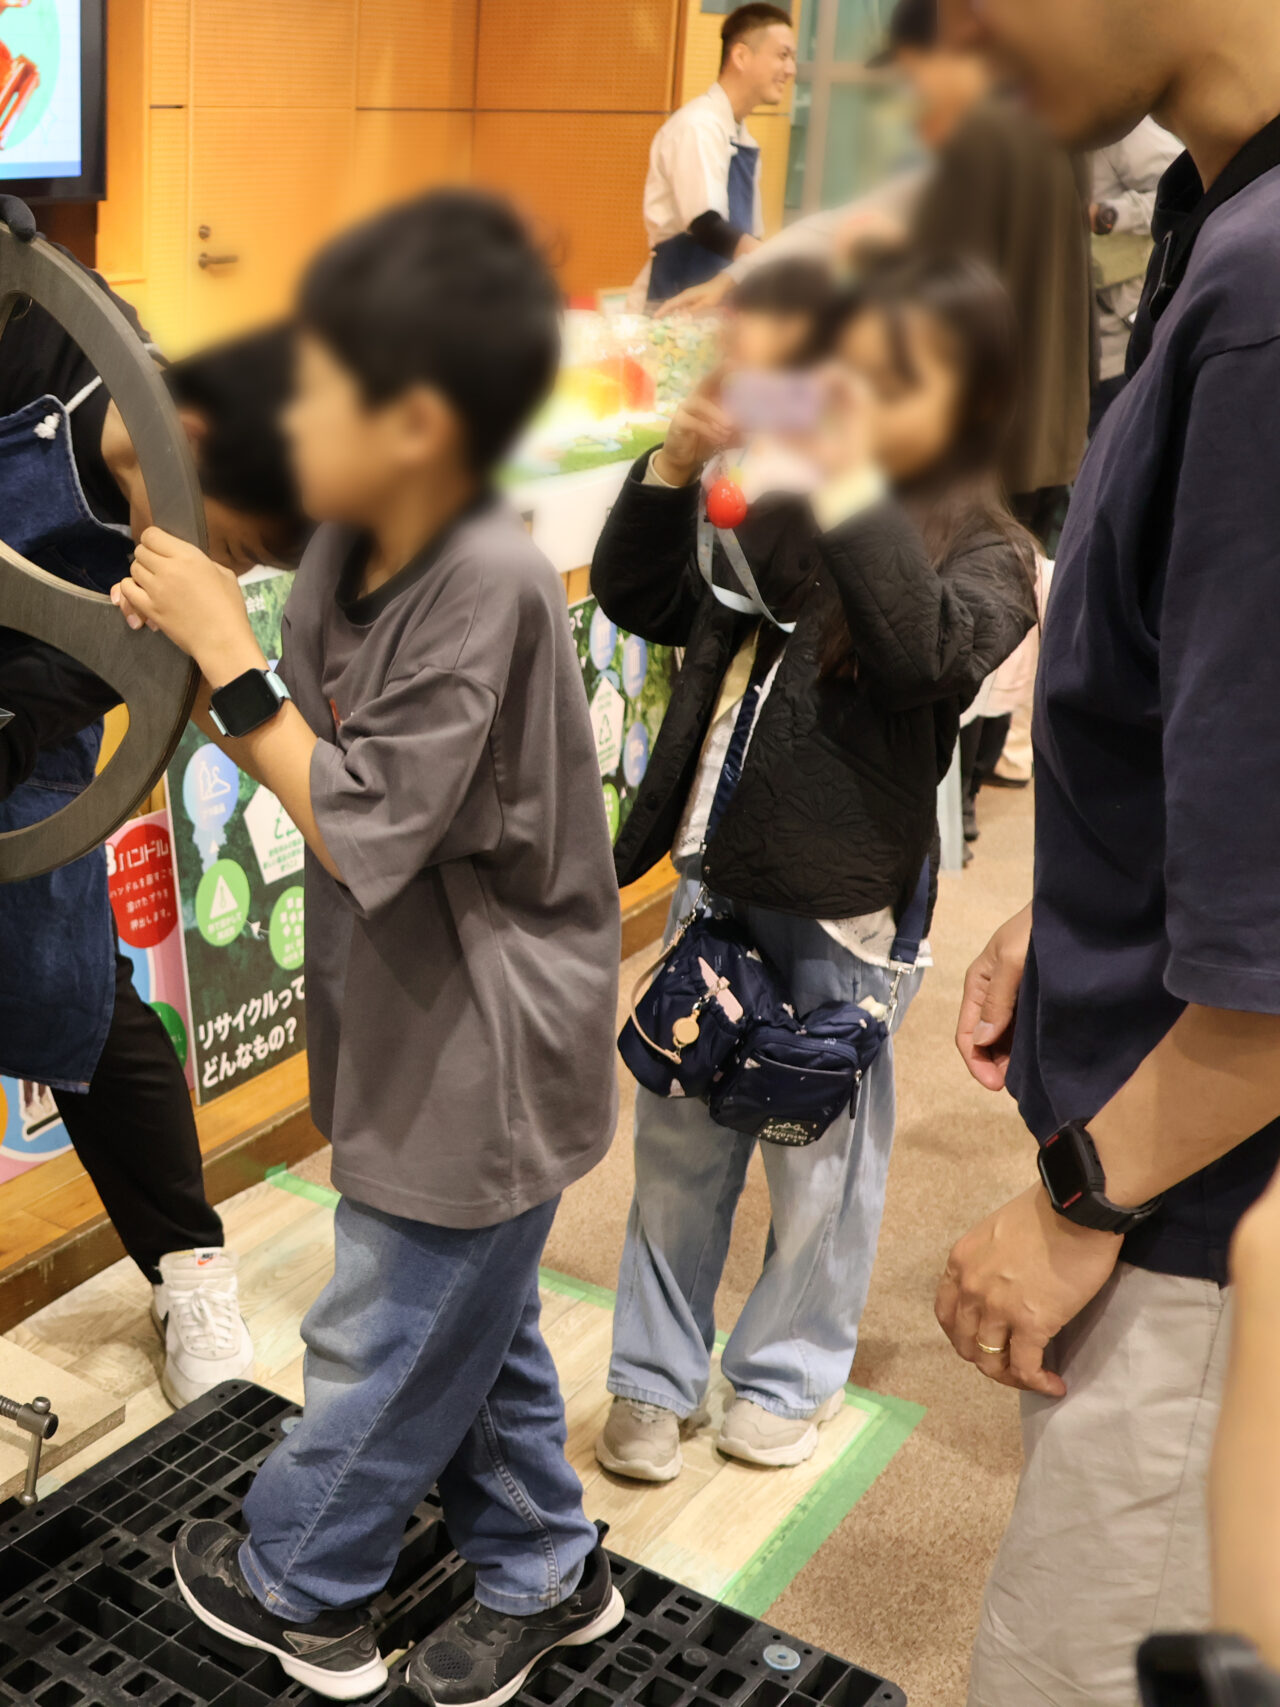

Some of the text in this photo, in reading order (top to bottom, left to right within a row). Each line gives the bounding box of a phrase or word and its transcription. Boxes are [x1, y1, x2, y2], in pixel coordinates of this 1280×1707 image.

[198, 974, 305, 1051] リサイクルって
